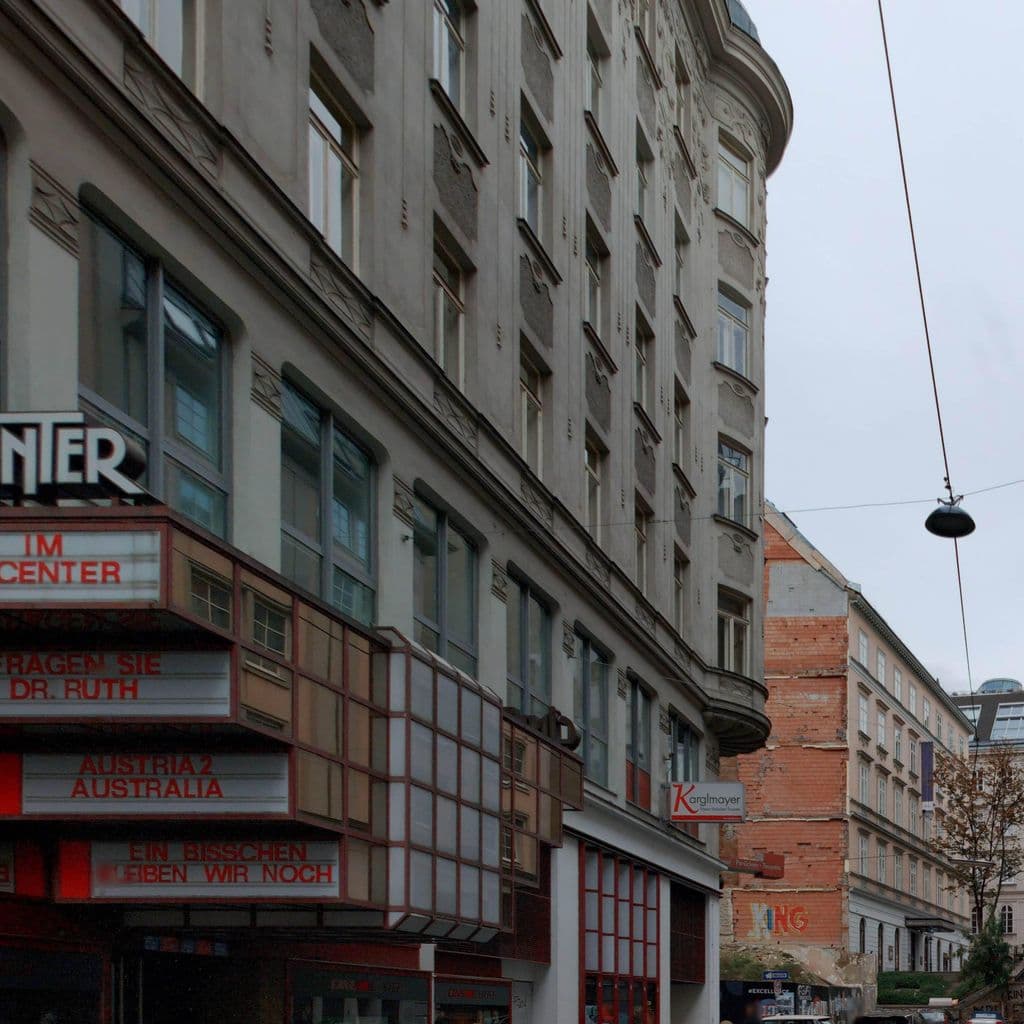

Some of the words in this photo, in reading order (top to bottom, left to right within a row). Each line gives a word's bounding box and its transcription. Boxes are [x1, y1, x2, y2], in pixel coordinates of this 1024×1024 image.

[0, 412, 145, 496] NTER
[24, 533, 64, 557] IM
[0, 561, 122, 584] CENTER
[0, 653, 106, 676] RAGEN
[117, 653, 162, 676] SIE
[10, 678, 56, 700] DR.
[64, 678, 139, 700] RUTH
[70, 778, 224, 799] AUSTRALIA
[672, 783, 741, 814] Karglmayer
[128, 842, 169, 861] EIN
[183, 842, 308, 861] BISSCHEN
[100, 864, 188, 884] LEIBEN
[204, 864, 249, 884] WIR
[262, 864, 333, 884] NOCH
